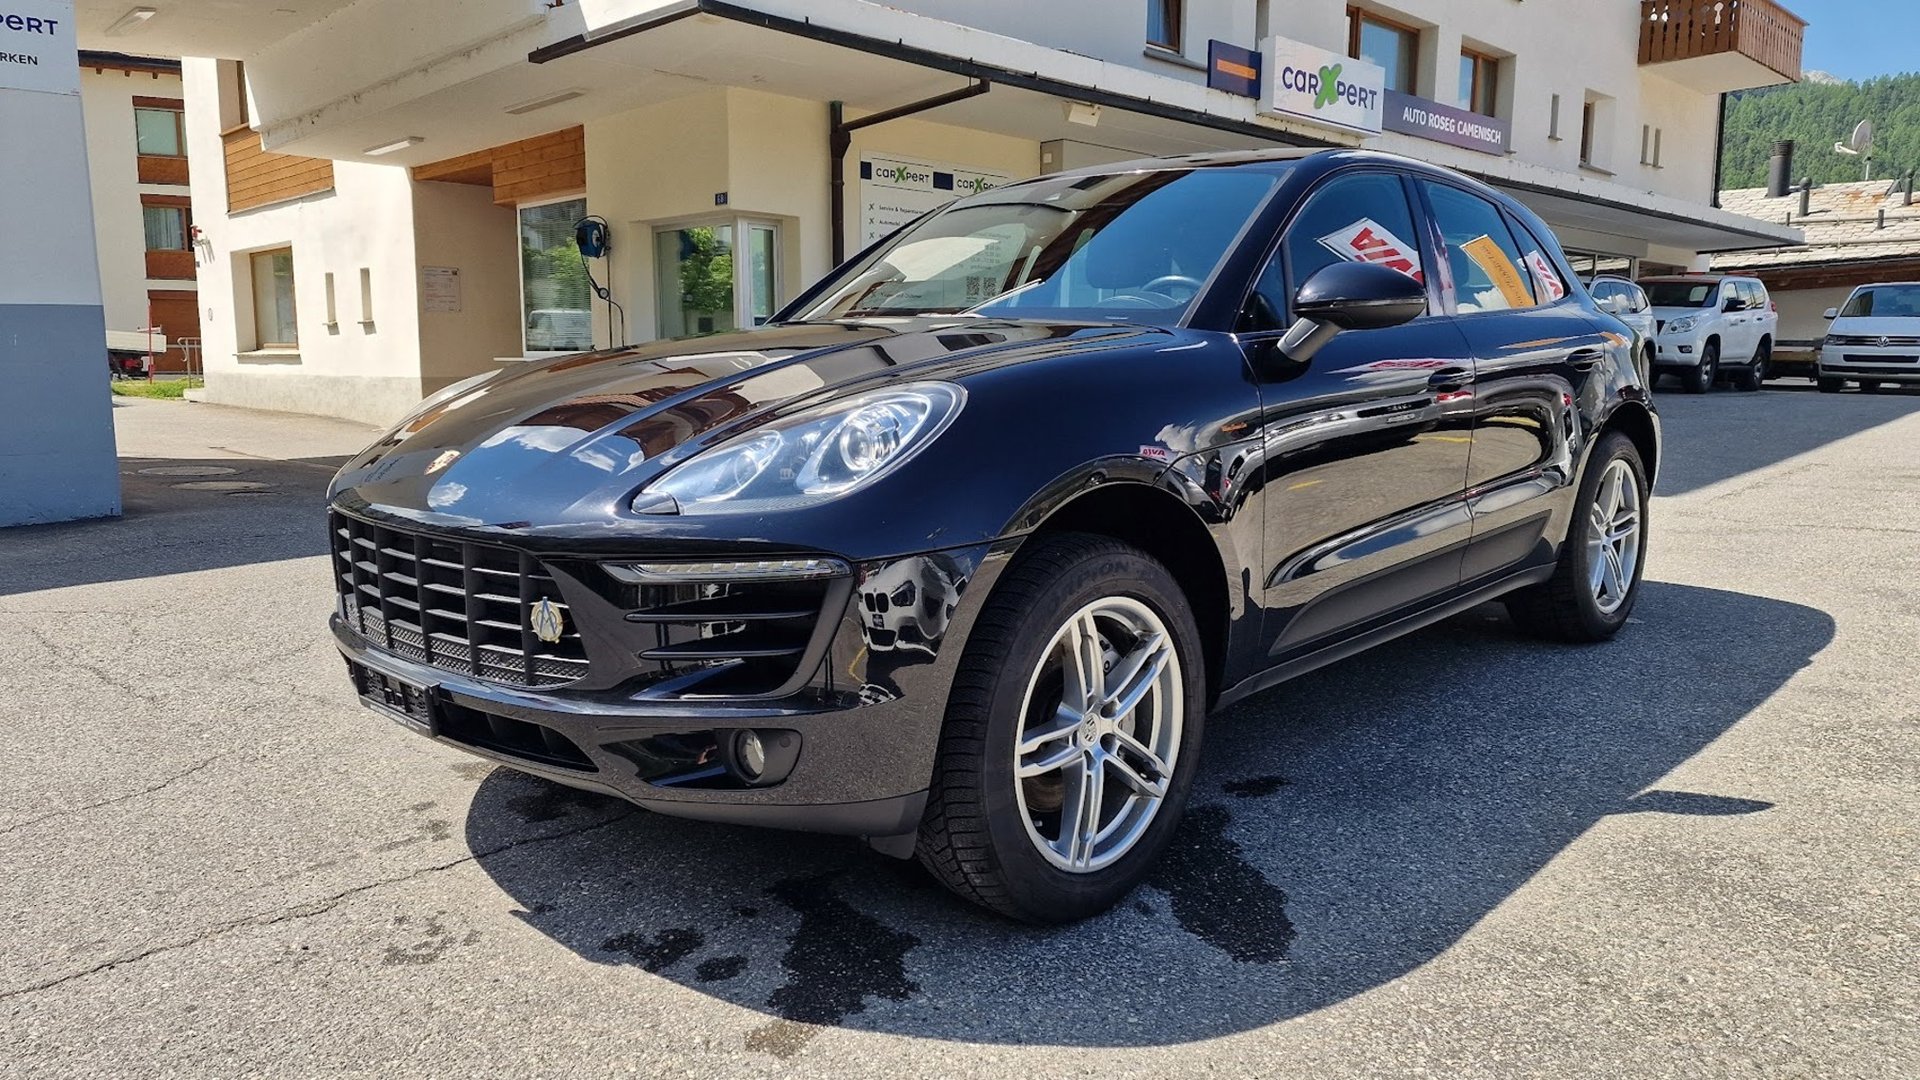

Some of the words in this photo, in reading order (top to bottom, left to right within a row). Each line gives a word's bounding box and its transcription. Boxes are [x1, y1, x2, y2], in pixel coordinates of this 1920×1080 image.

[1402, 106, 1427, 126] AUTO
[1428, 112, 1455, 133] ROSEG
[1457, 120, 1502, 145] CAMENISCH
